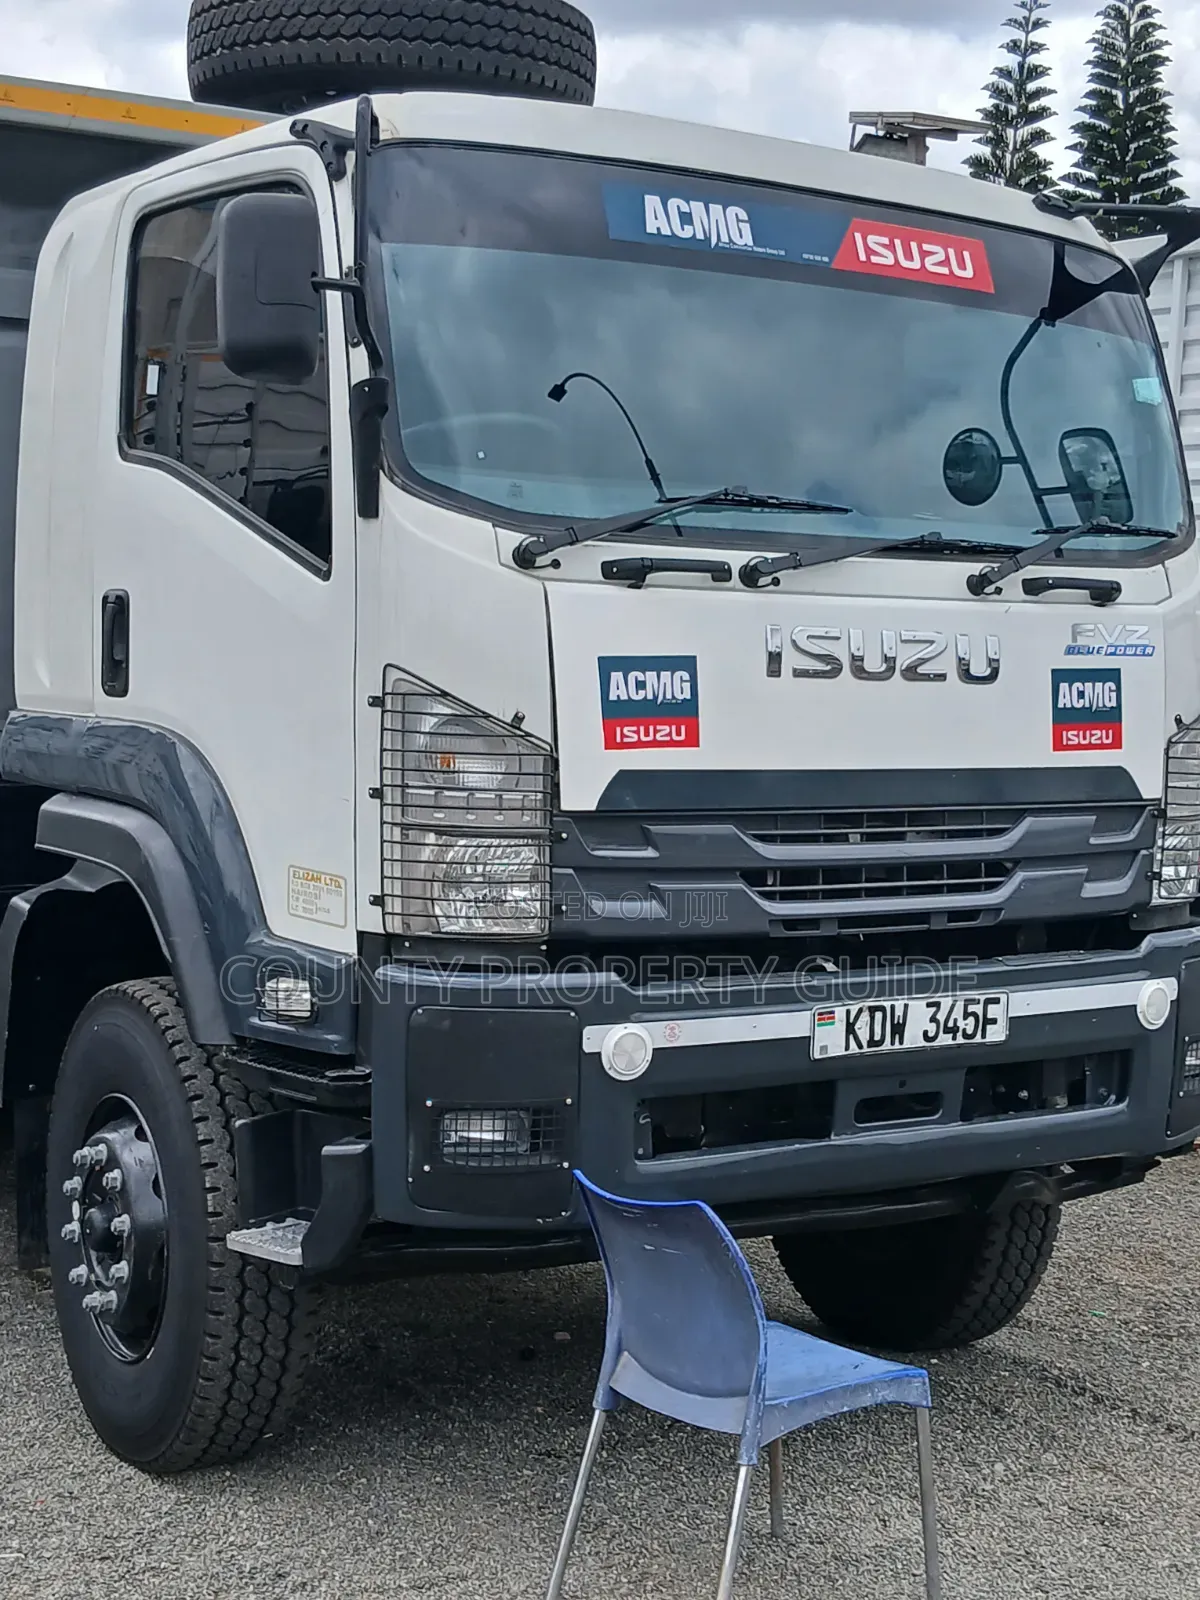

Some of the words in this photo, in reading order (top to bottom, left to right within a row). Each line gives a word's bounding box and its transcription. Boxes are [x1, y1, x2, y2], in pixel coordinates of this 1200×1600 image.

[644, 194, 754, 249] ACMG
[853, 232, 974, 279] ISUZU
[1071, 623, 1150, 644] FVZ
[765, 624, 1001, 685] ISUZU
[608, 670, 692, 705] ACMG
[1057, 682, 1117, 712] ACMG
[616, 724, 687, 743] ISUZU
[1062, 729, 1113, 746] ISUZU
[291, 870, 322, 884] ELIZAH
[844, 1002, 910, 1052] KDW
[922, 996, 1002, 1044] 345F
